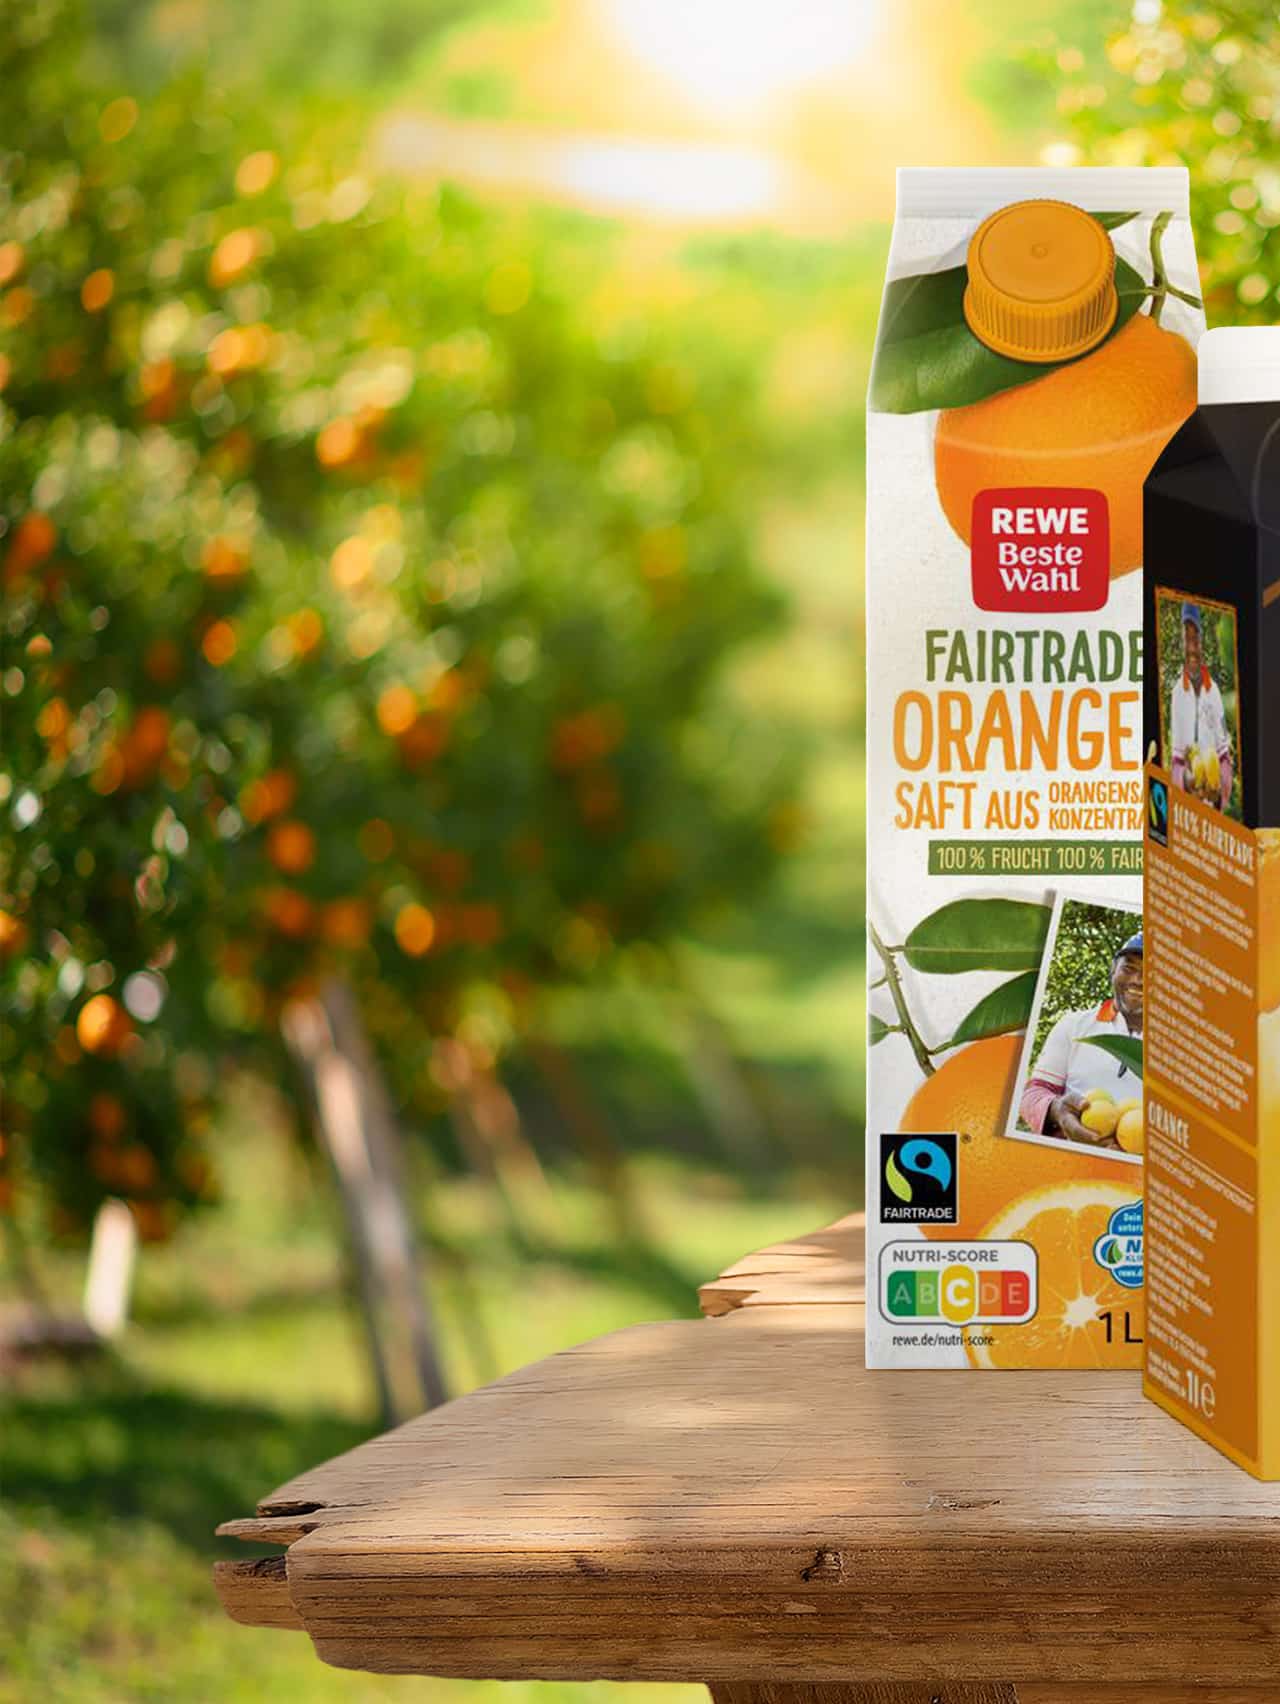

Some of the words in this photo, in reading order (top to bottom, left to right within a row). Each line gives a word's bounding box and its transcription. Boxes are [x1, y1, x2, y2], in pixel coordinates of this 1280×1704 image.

[991, 508, 1089, 535] REWE
[998, 542, 1083, 567] Beste
[999, 568, 1081, 593] Wahl
[925, 629, 1143, 684] FAIRTRADE
[892, 687, 1139, 773] ORANGE
[895, 780, 977, 831] SAFT
[985, 791, 1041, 831] AUS
[937, 847, 966, 870] 100
[992, 847, 1052, 870] FRUCHT
[1056, 847, 1086, 870] 100
[1111, 847, 1143, 870] FAIR
[1148, 1101, 1190, 1149] ORANGE
[883, 1207, 953, 1219] FAIRTRADE
[892, 1249, 999, 1263] NUTRI-SCORE
[892, 1332, 995, 1347] rewe.de/nutri-score
